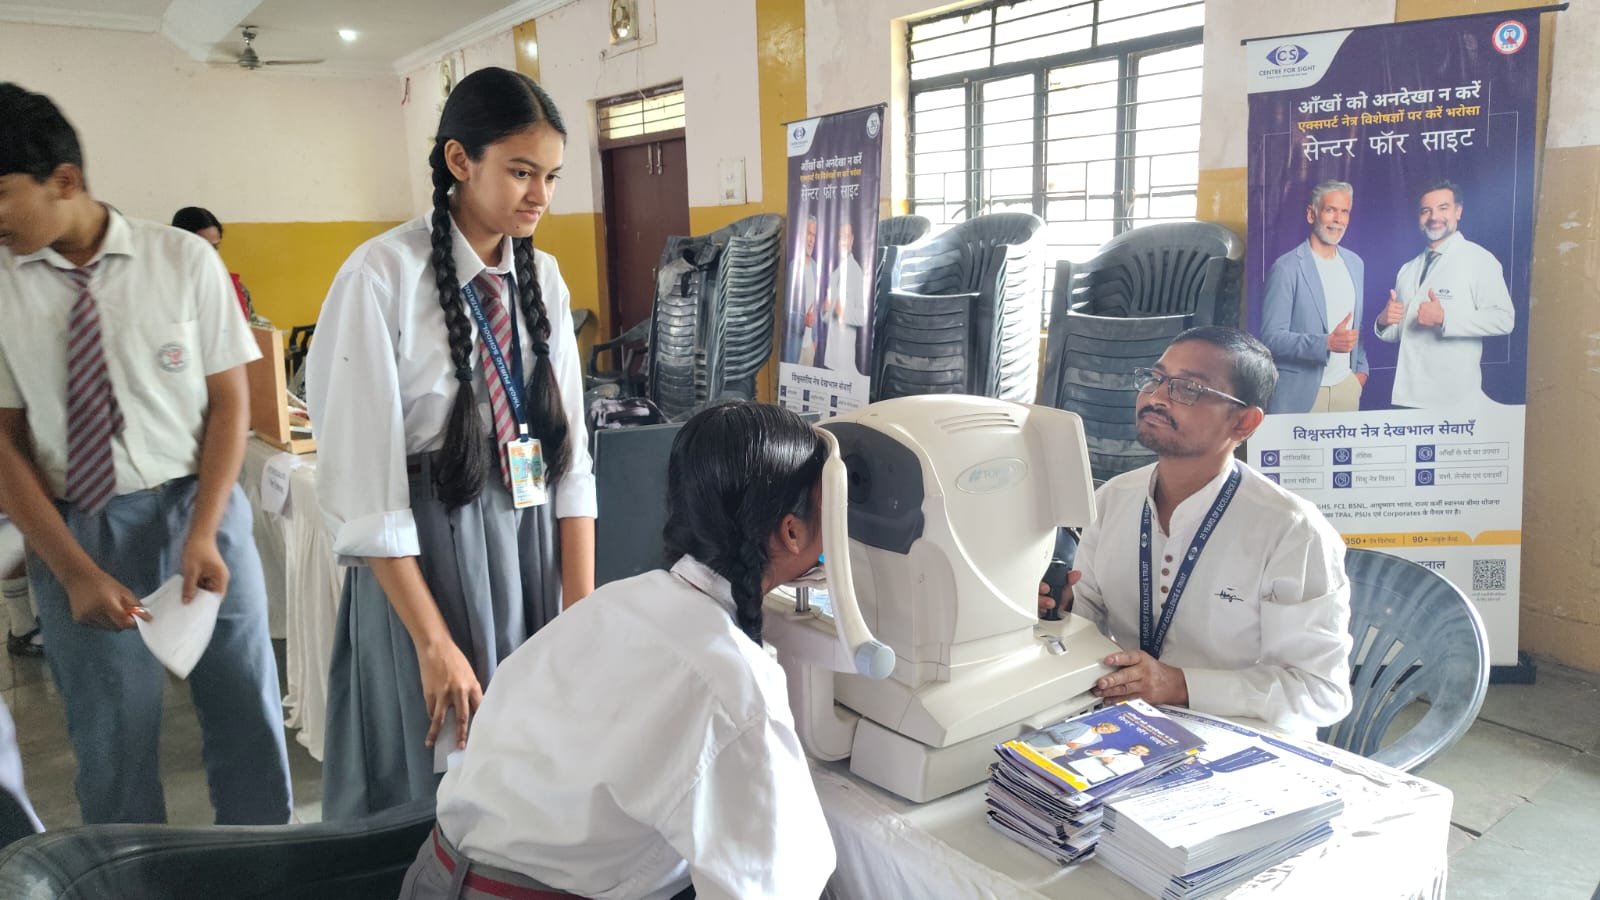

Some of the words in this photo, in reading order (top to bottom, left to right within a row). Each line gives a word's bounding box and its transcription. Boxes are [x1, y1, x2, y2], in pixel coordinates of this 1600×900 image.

[1277, 49, 1297, 61] CS
[1298, 93, 1343, 114] आँखों
[1346, 91, 1369, 110] को
[1372, 87, 1435, 107] अनदेखा
[1438, 87, 1452, 101] न
[1455, 80, 1482, 100] करें
[1297, 115, 1340, 133] एक्सपर्ट
[1341, 114, 1359, 127] नेत्र
[1361, 109, 1406, 126] विशेषज्ञों
[1407, 111, 1423, 121] पर
[1425, 105, 1444, 120] करें
[1446, 104, 1481, 118] भरोसा
[1302, 135, 1359, 162] सेन्टर
[1369, 130, 1410, 155] फॉर
[1421, 128, 1476, 153] साइट
[463, 284, 485, 321] KANTATOL
[496, 357, 511, 385] PUBLIC
[1293, 425, 1357, 441] विश्वस्तरीय
[1361, 423, 1380, 438] नेत्र
[1384, 422, 1435, 438] देखभाल
[1438, 419, 1477, 436] सेवाएँ
[1383, 509, 1421, 518] Corporates
[1412, 535, 1429, 544] 90+
